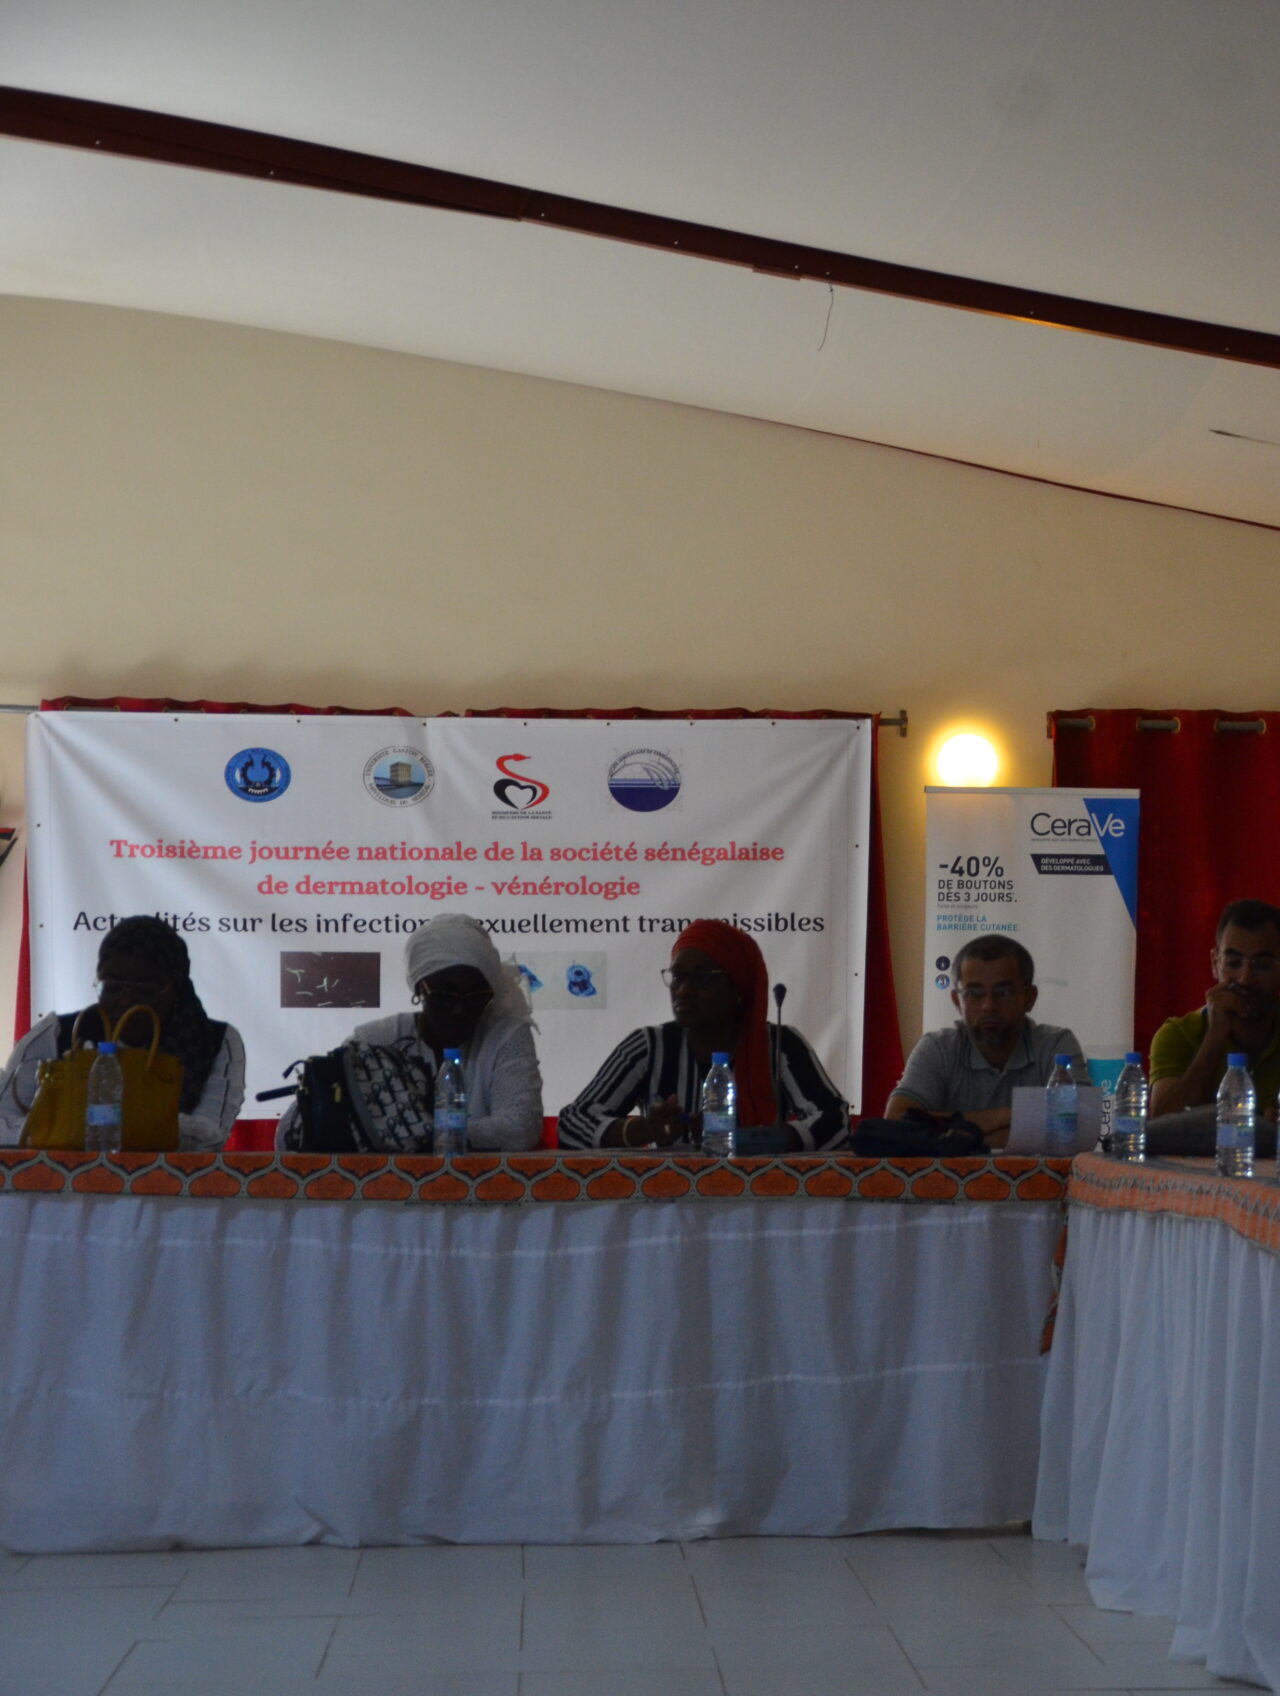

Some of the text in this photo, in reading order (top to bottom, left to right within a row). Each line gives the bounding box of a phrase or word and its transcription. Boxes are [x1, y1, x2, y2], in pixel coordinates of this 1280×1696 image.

[1030, 812, 1126, 838] CeraVe
[109, 840, 785, 866] Troisième journée nationale de la société sénégalaise
[939, 855, 1005, 878] -40%
[257, 875, 289, 895] de
[295, 875, 468, 901] dermatologie
[492, 876, 641, 901] vénérologie
[938, 879, 1014, 890] DE BOUTONS
[964, 892, 971, 902] 3
[974, 892, 1018, 902] JOURS.
[218, 917, 263, 933] sur
[271, 913, 309, 933] les
[976, 914, 987, 922] LA
